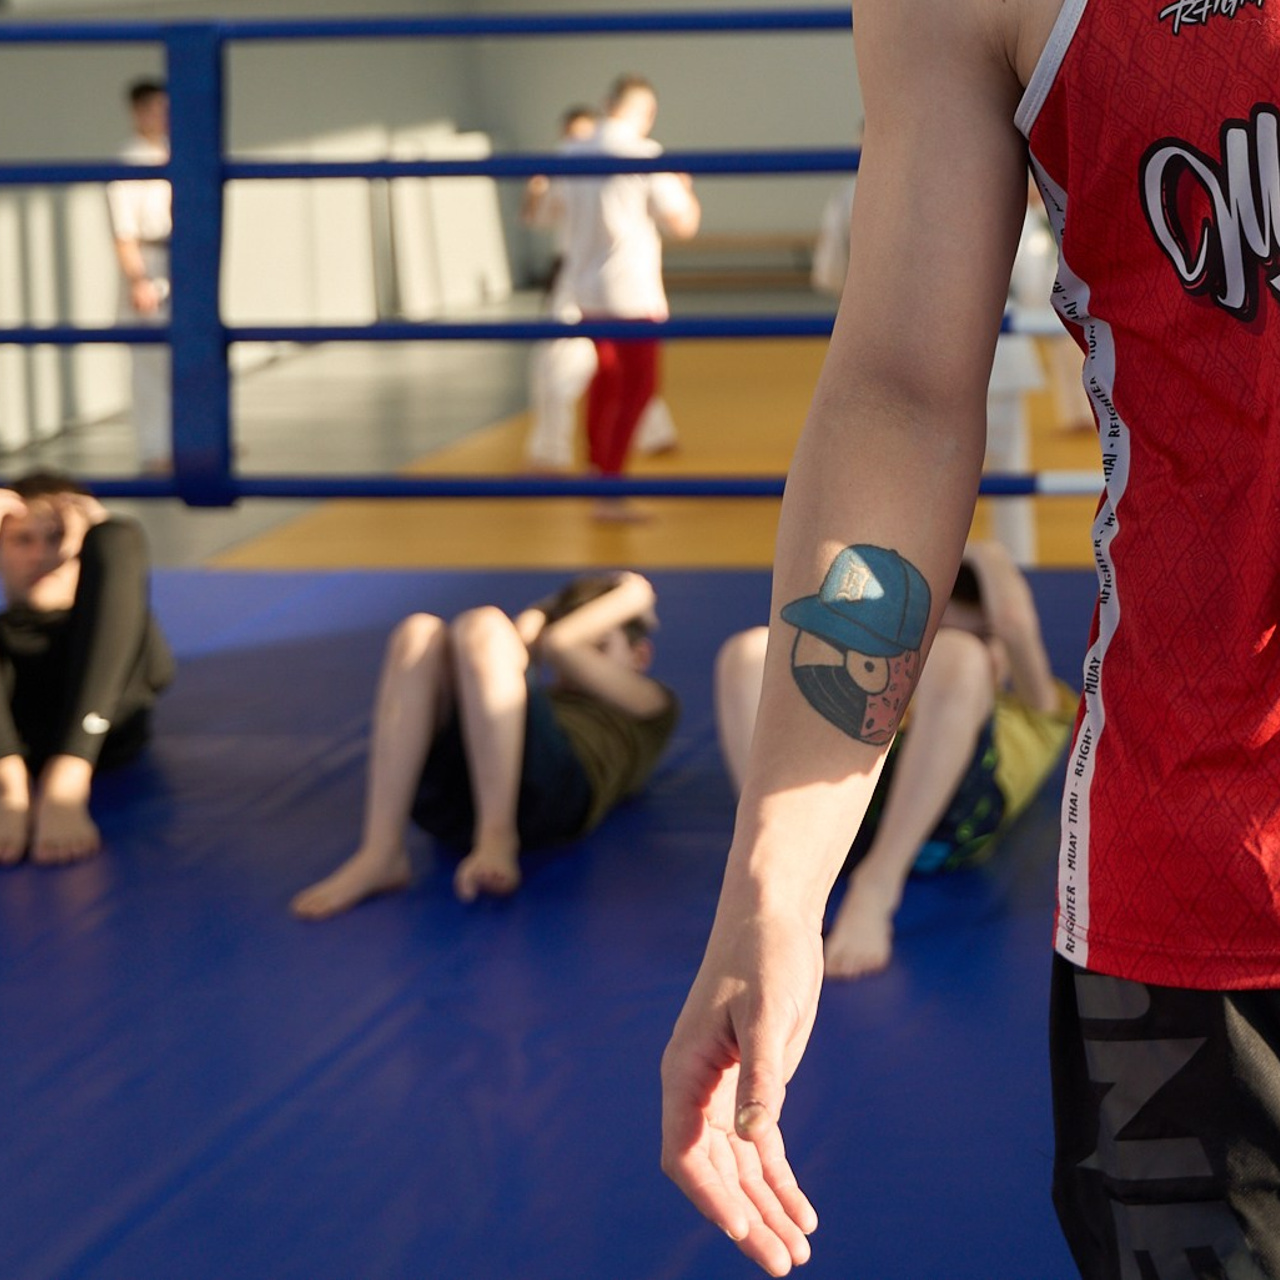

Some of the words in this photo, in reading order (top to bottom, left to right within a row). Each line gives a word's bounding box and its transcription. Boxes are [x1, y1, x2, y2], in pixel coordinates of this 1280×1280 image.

[1089, 376, 1120, 437] RFIGHTER
[1084, 656, 1102, 695] MUAY
[1068, 792, 1079, 824] THAI
[1067, 832, 1078, 871] MUAY
[1065, 885, 1077, 954] RFIGHTER
